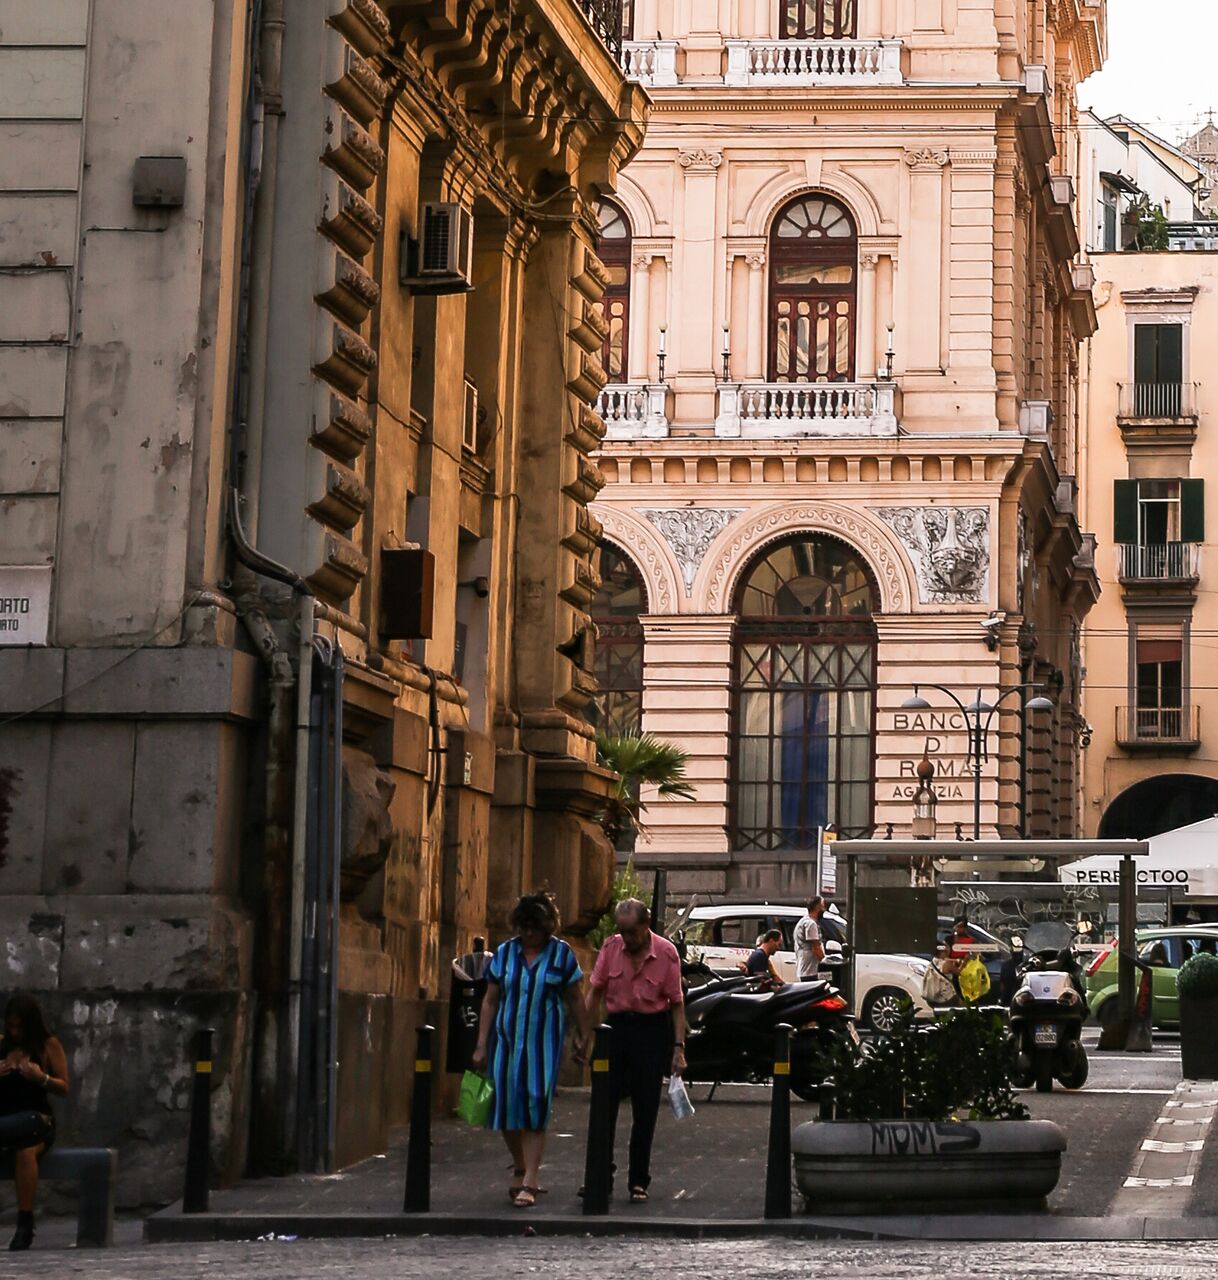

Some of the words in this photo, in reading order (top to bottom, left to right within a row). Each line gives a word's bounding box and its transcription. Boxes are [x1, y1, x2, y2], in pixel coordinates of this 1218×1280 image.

[894, 713, 977, 729] BANC
[900, 760, 973, 776] RMA
[892, 785, 963, 798] AGZIA
[1077, 870, 1189, 883] PERFCTOO
